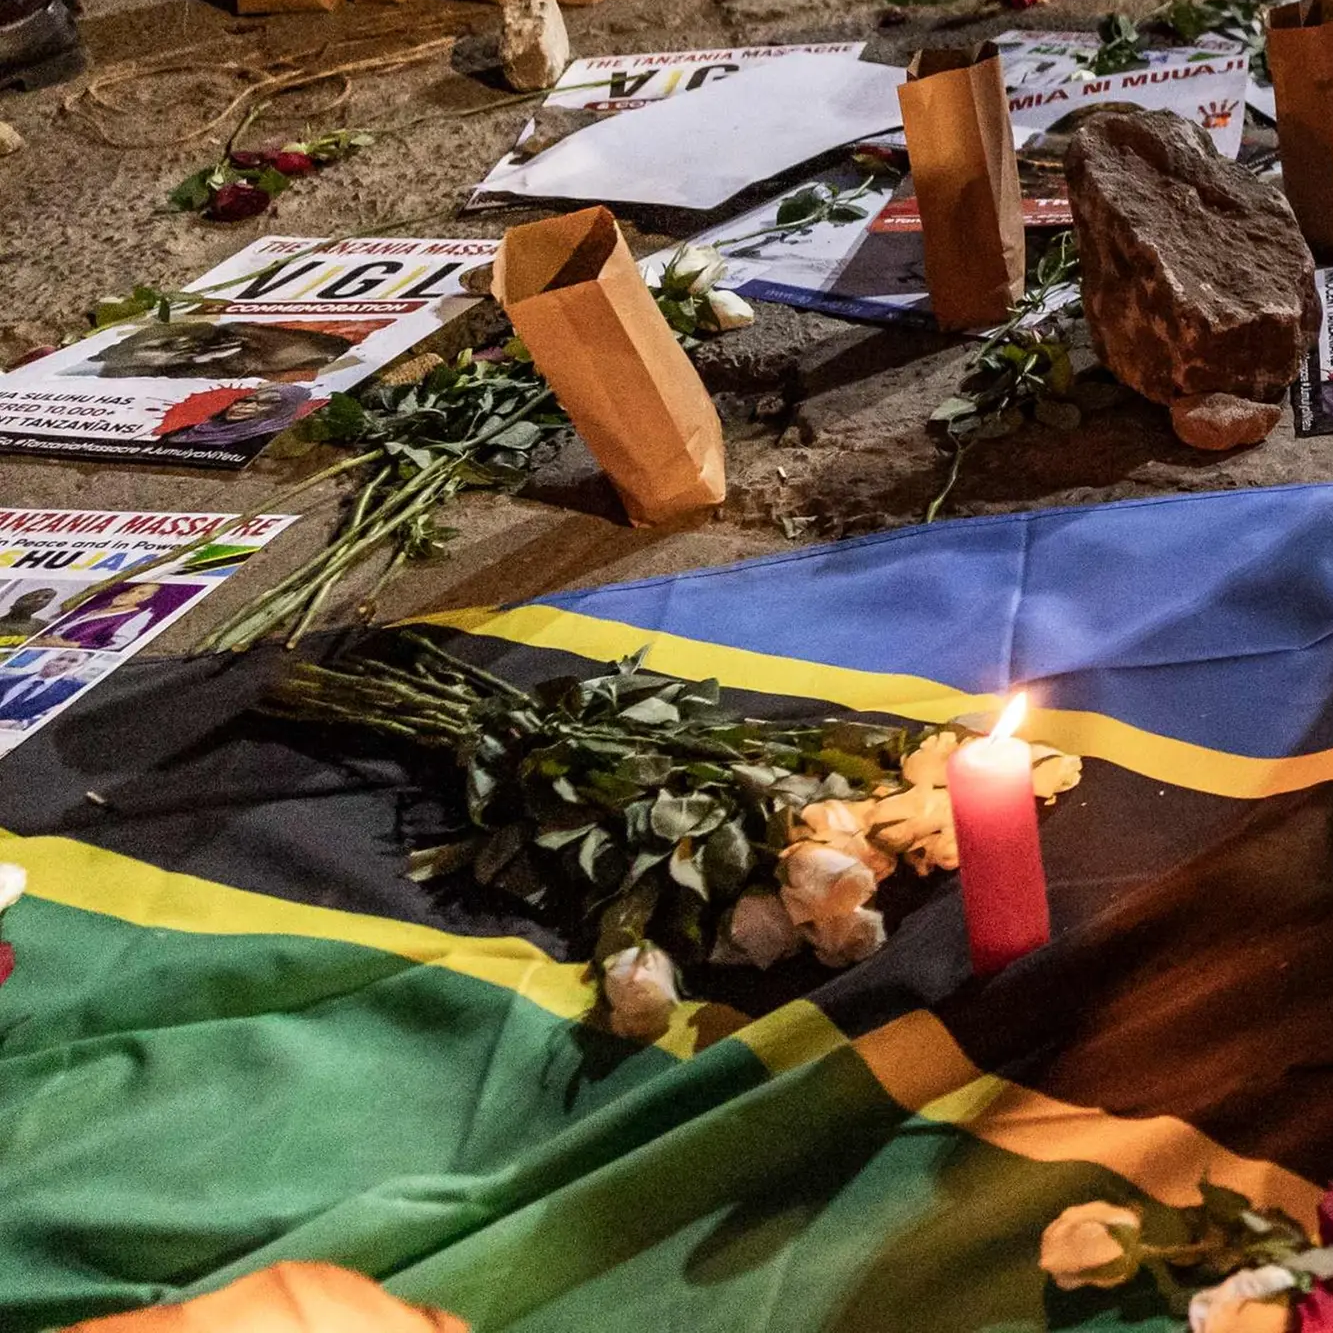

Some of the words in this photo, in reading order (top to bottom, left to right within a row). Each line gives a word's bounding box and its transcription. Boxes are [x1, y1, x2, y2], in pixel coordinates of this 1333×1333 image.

[586, 56, 628, 71] THE
[633, 50, 734, 68] TANZANIA
[1008, 87, 1069, 112] MIA
[1082, 81, 1111, 96] NI
[1122, 58, 1245, 88] MUUAJI
[261, 241, 309, 254] THE
[418, 242, 499, 256] MASSA
[235, 261, 465, 300] VIGIL
[225, 303, 413, 314] COMMEMORATION
[21, 392, 94, 404] SULUHU
[93, 395, 136, 406] HAS
[49, 405, 116, 417] 10,000+
[18, 417, 145, 434] TANZANIANS!
[15, 438, 140, 454] #TanzaniaMassacre
[141, 446, 247, 463] #JumuiyaNiYetu
[0, 511, 118, 536] ANZANIA
[114, 516, 282, 538] MASSARE
[9, 538, 69, 549] Peace
[71, 538, 109, 549] and
[111, 540, 132, 550] in
[135, 540, 182, 551] Powe
